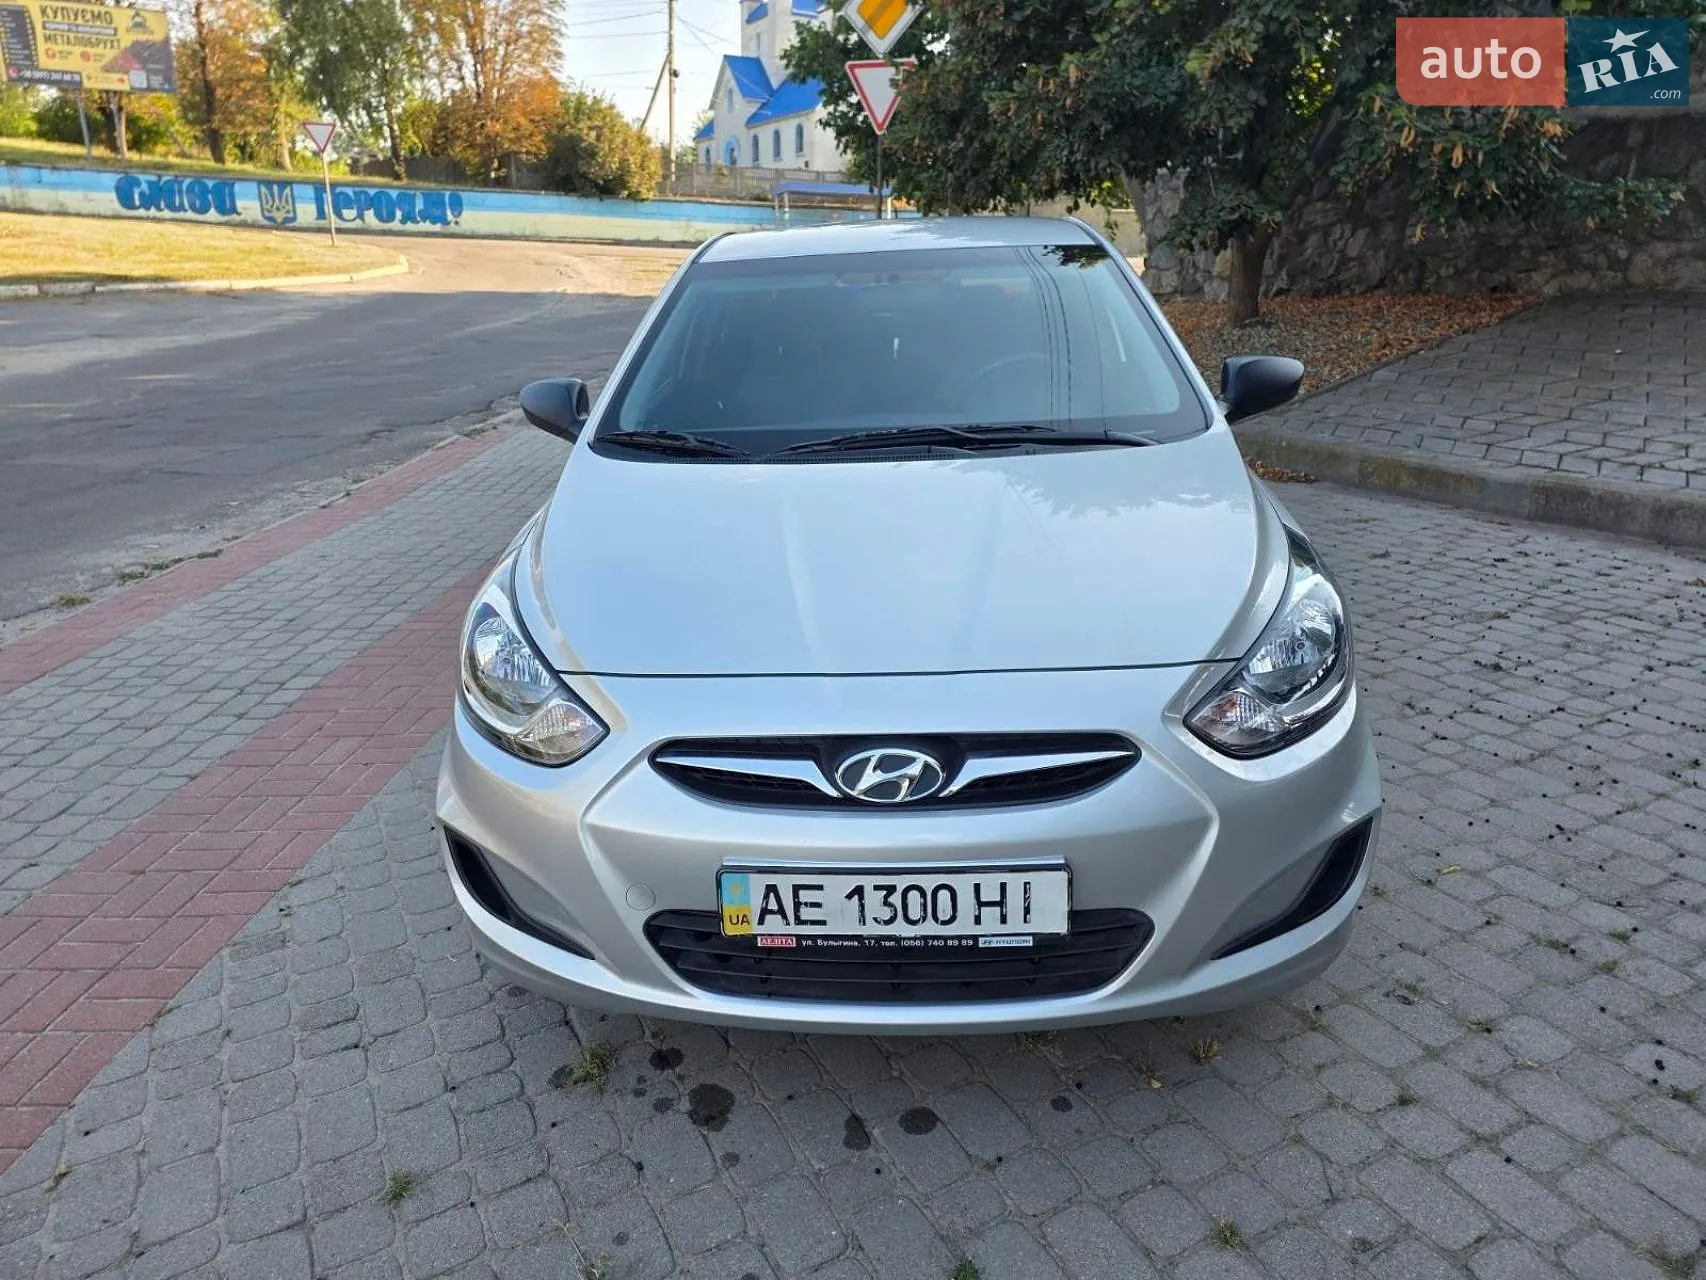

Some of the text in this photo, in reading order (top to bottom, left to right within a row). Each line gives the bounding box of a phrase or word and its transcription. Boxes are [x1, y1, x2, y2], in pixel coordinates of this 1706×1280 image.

[39, 4, 113, 25] КУПУЄМО
[757, 883, 828, 927] AE
[844, 883, 959, 927] 1300
[729, 913, 751, 926] UA
[995, 938, 1031, 946] HYUNDAI
